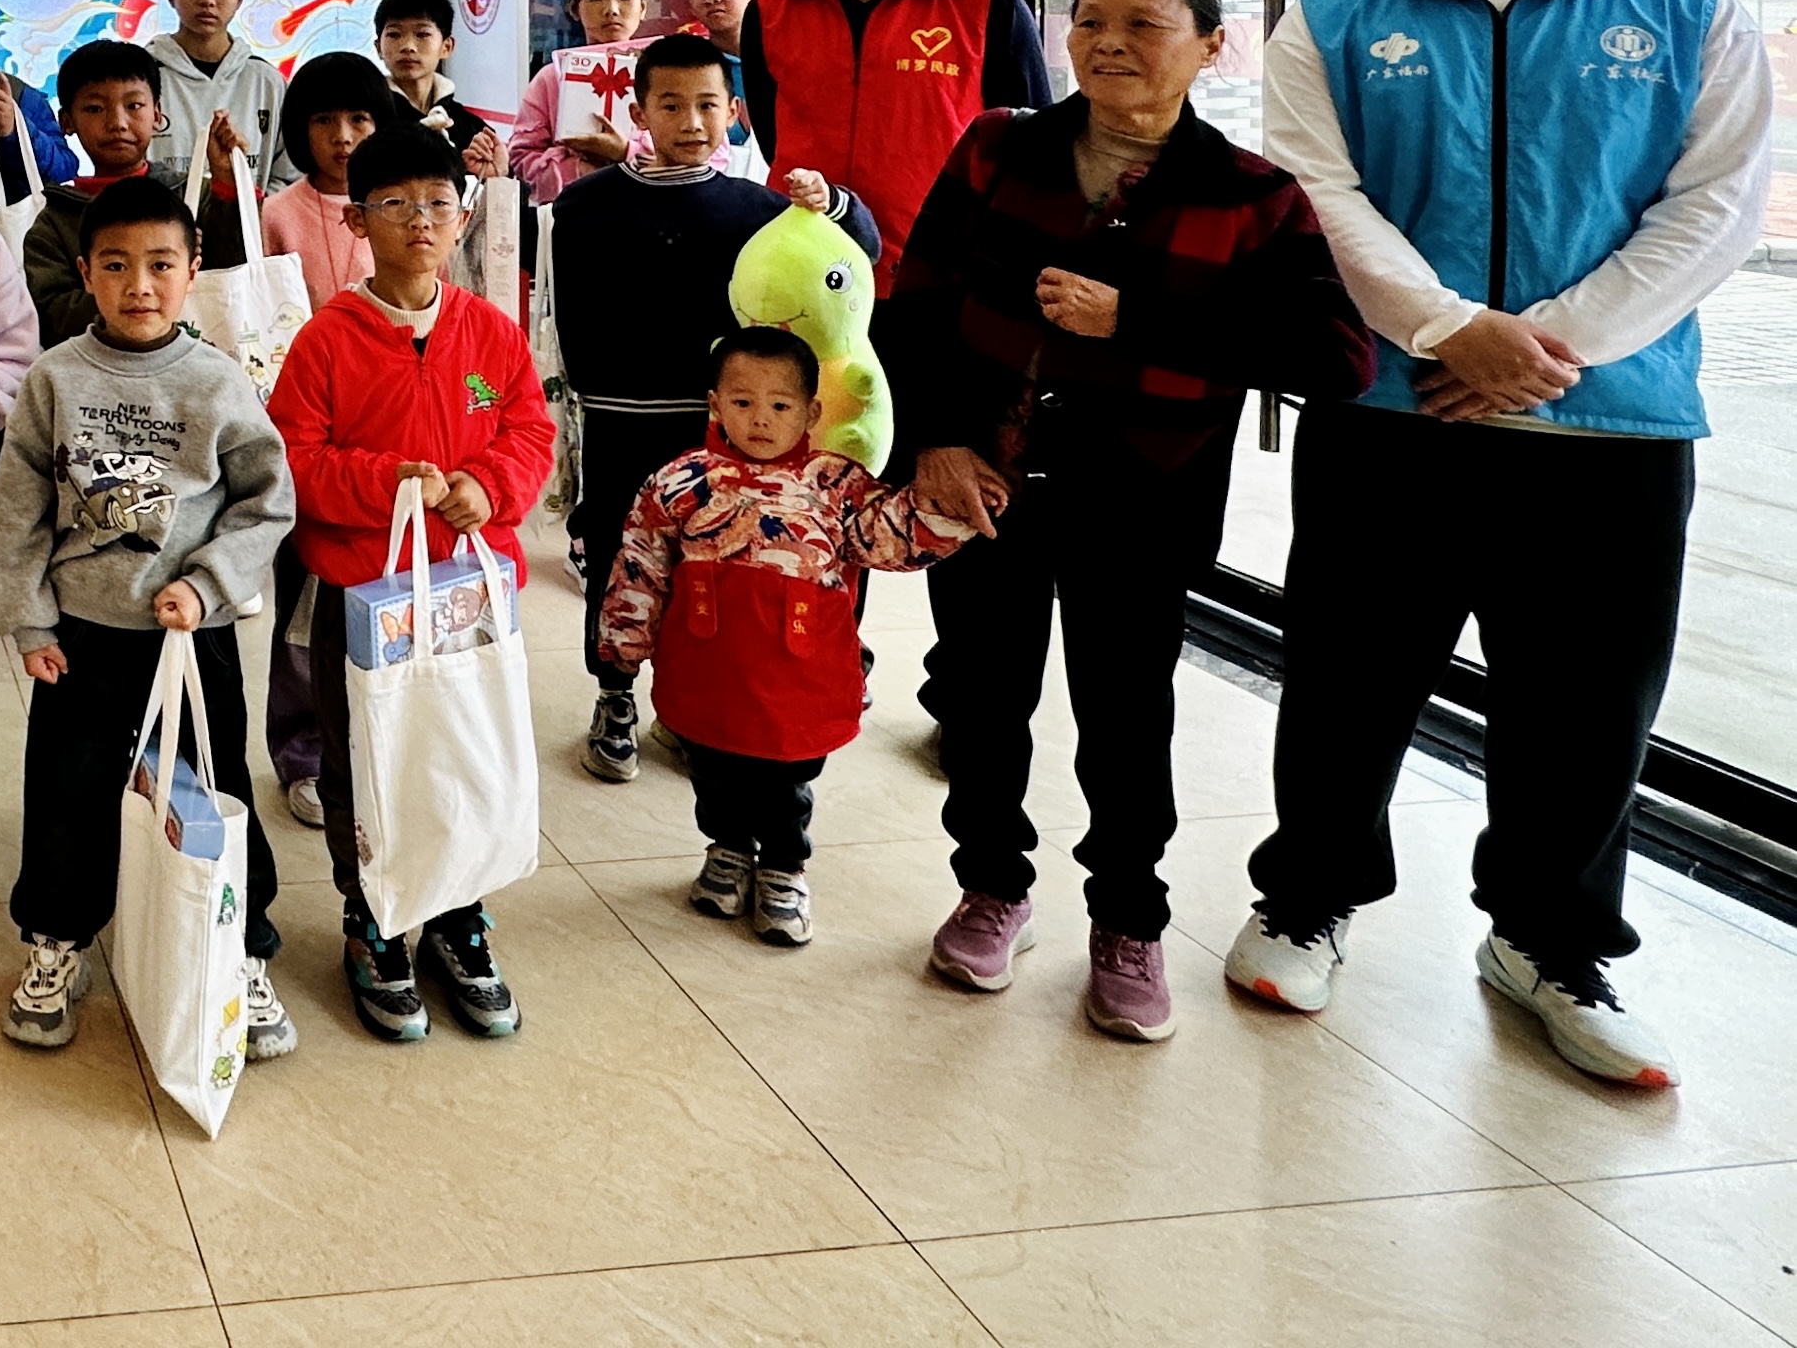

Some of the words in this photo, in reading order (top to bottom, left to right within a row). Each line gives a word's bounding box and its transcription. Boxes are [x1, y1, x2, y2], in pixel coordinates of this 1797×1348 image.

[896, 59, 960, 77] 博罗民政
[117, 403, 151, 416] NEW
[79, 407, 186, 433] TERRYTOONS
